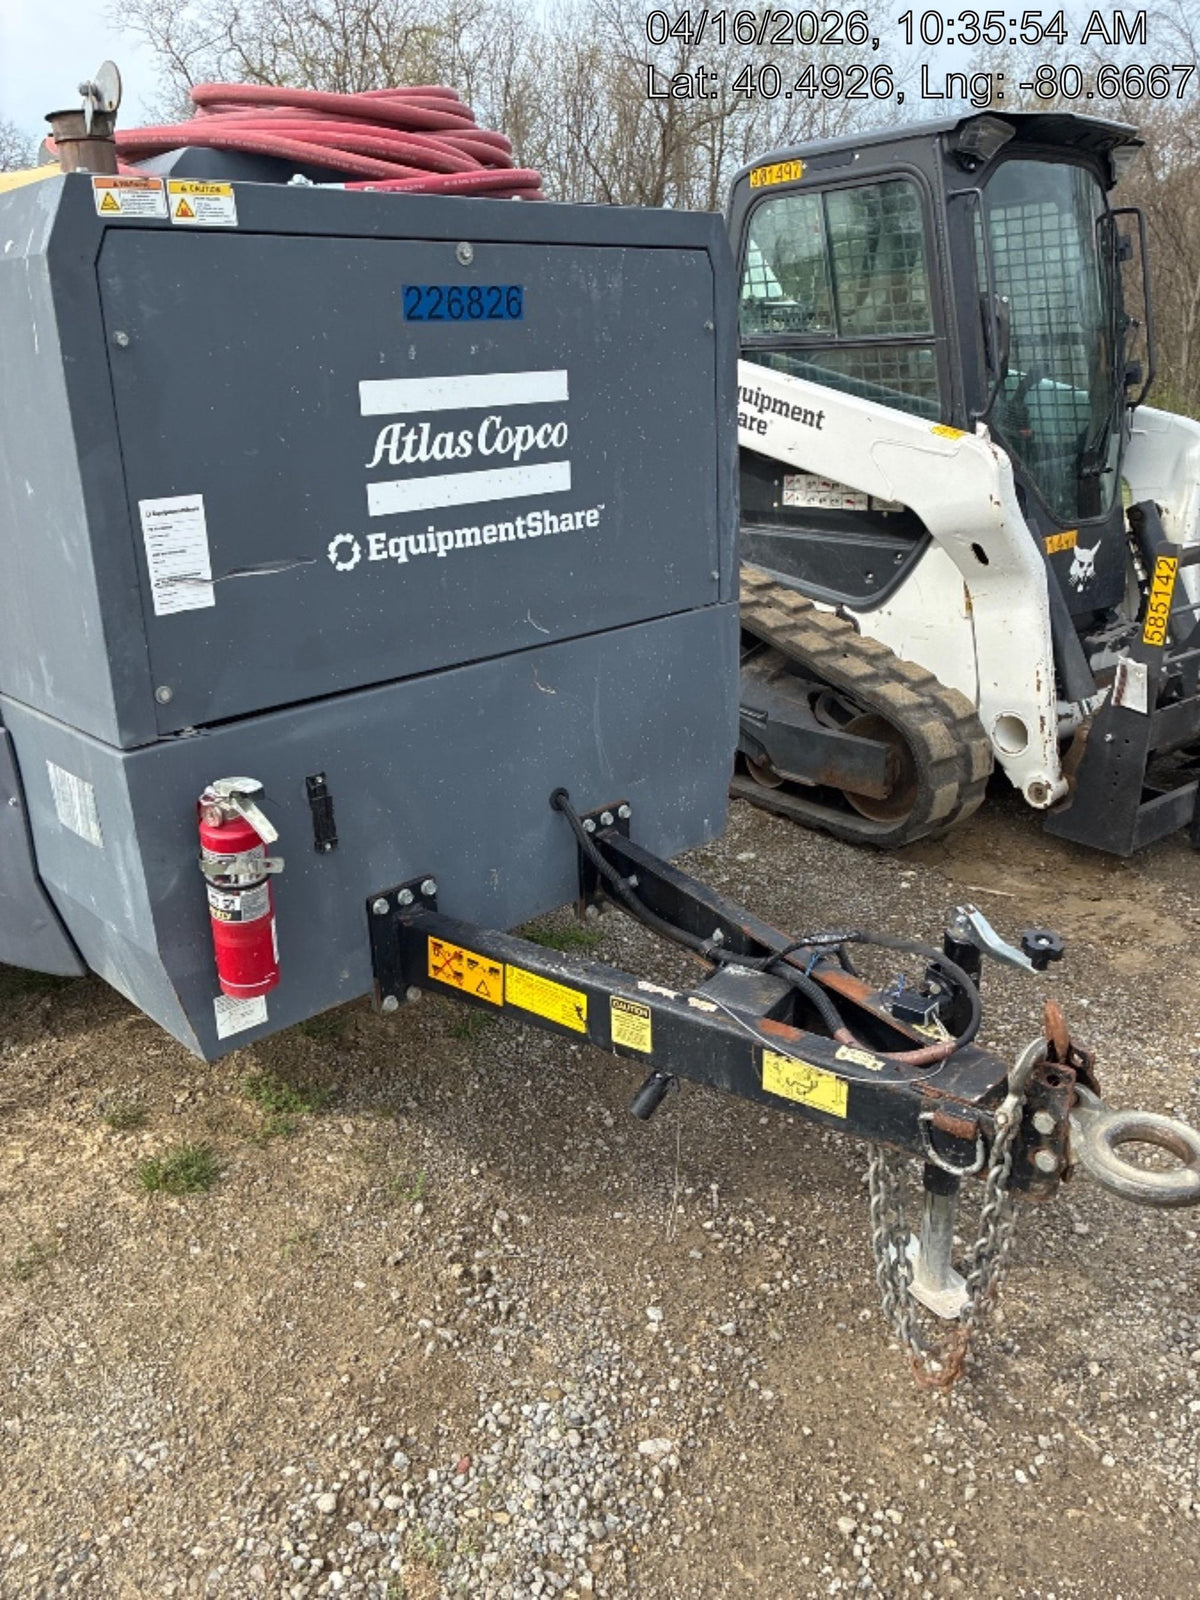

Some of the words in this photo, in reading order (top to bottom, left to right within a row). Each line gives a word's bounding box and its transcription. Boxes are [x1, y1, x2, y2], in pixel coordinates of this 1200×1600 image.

[404, 285, 523, 321] 226826
[364, 422, 474, 469] Atlas
[477, 415, 569, 461] Copco
[1143, 558, 1177, 644] 585142
